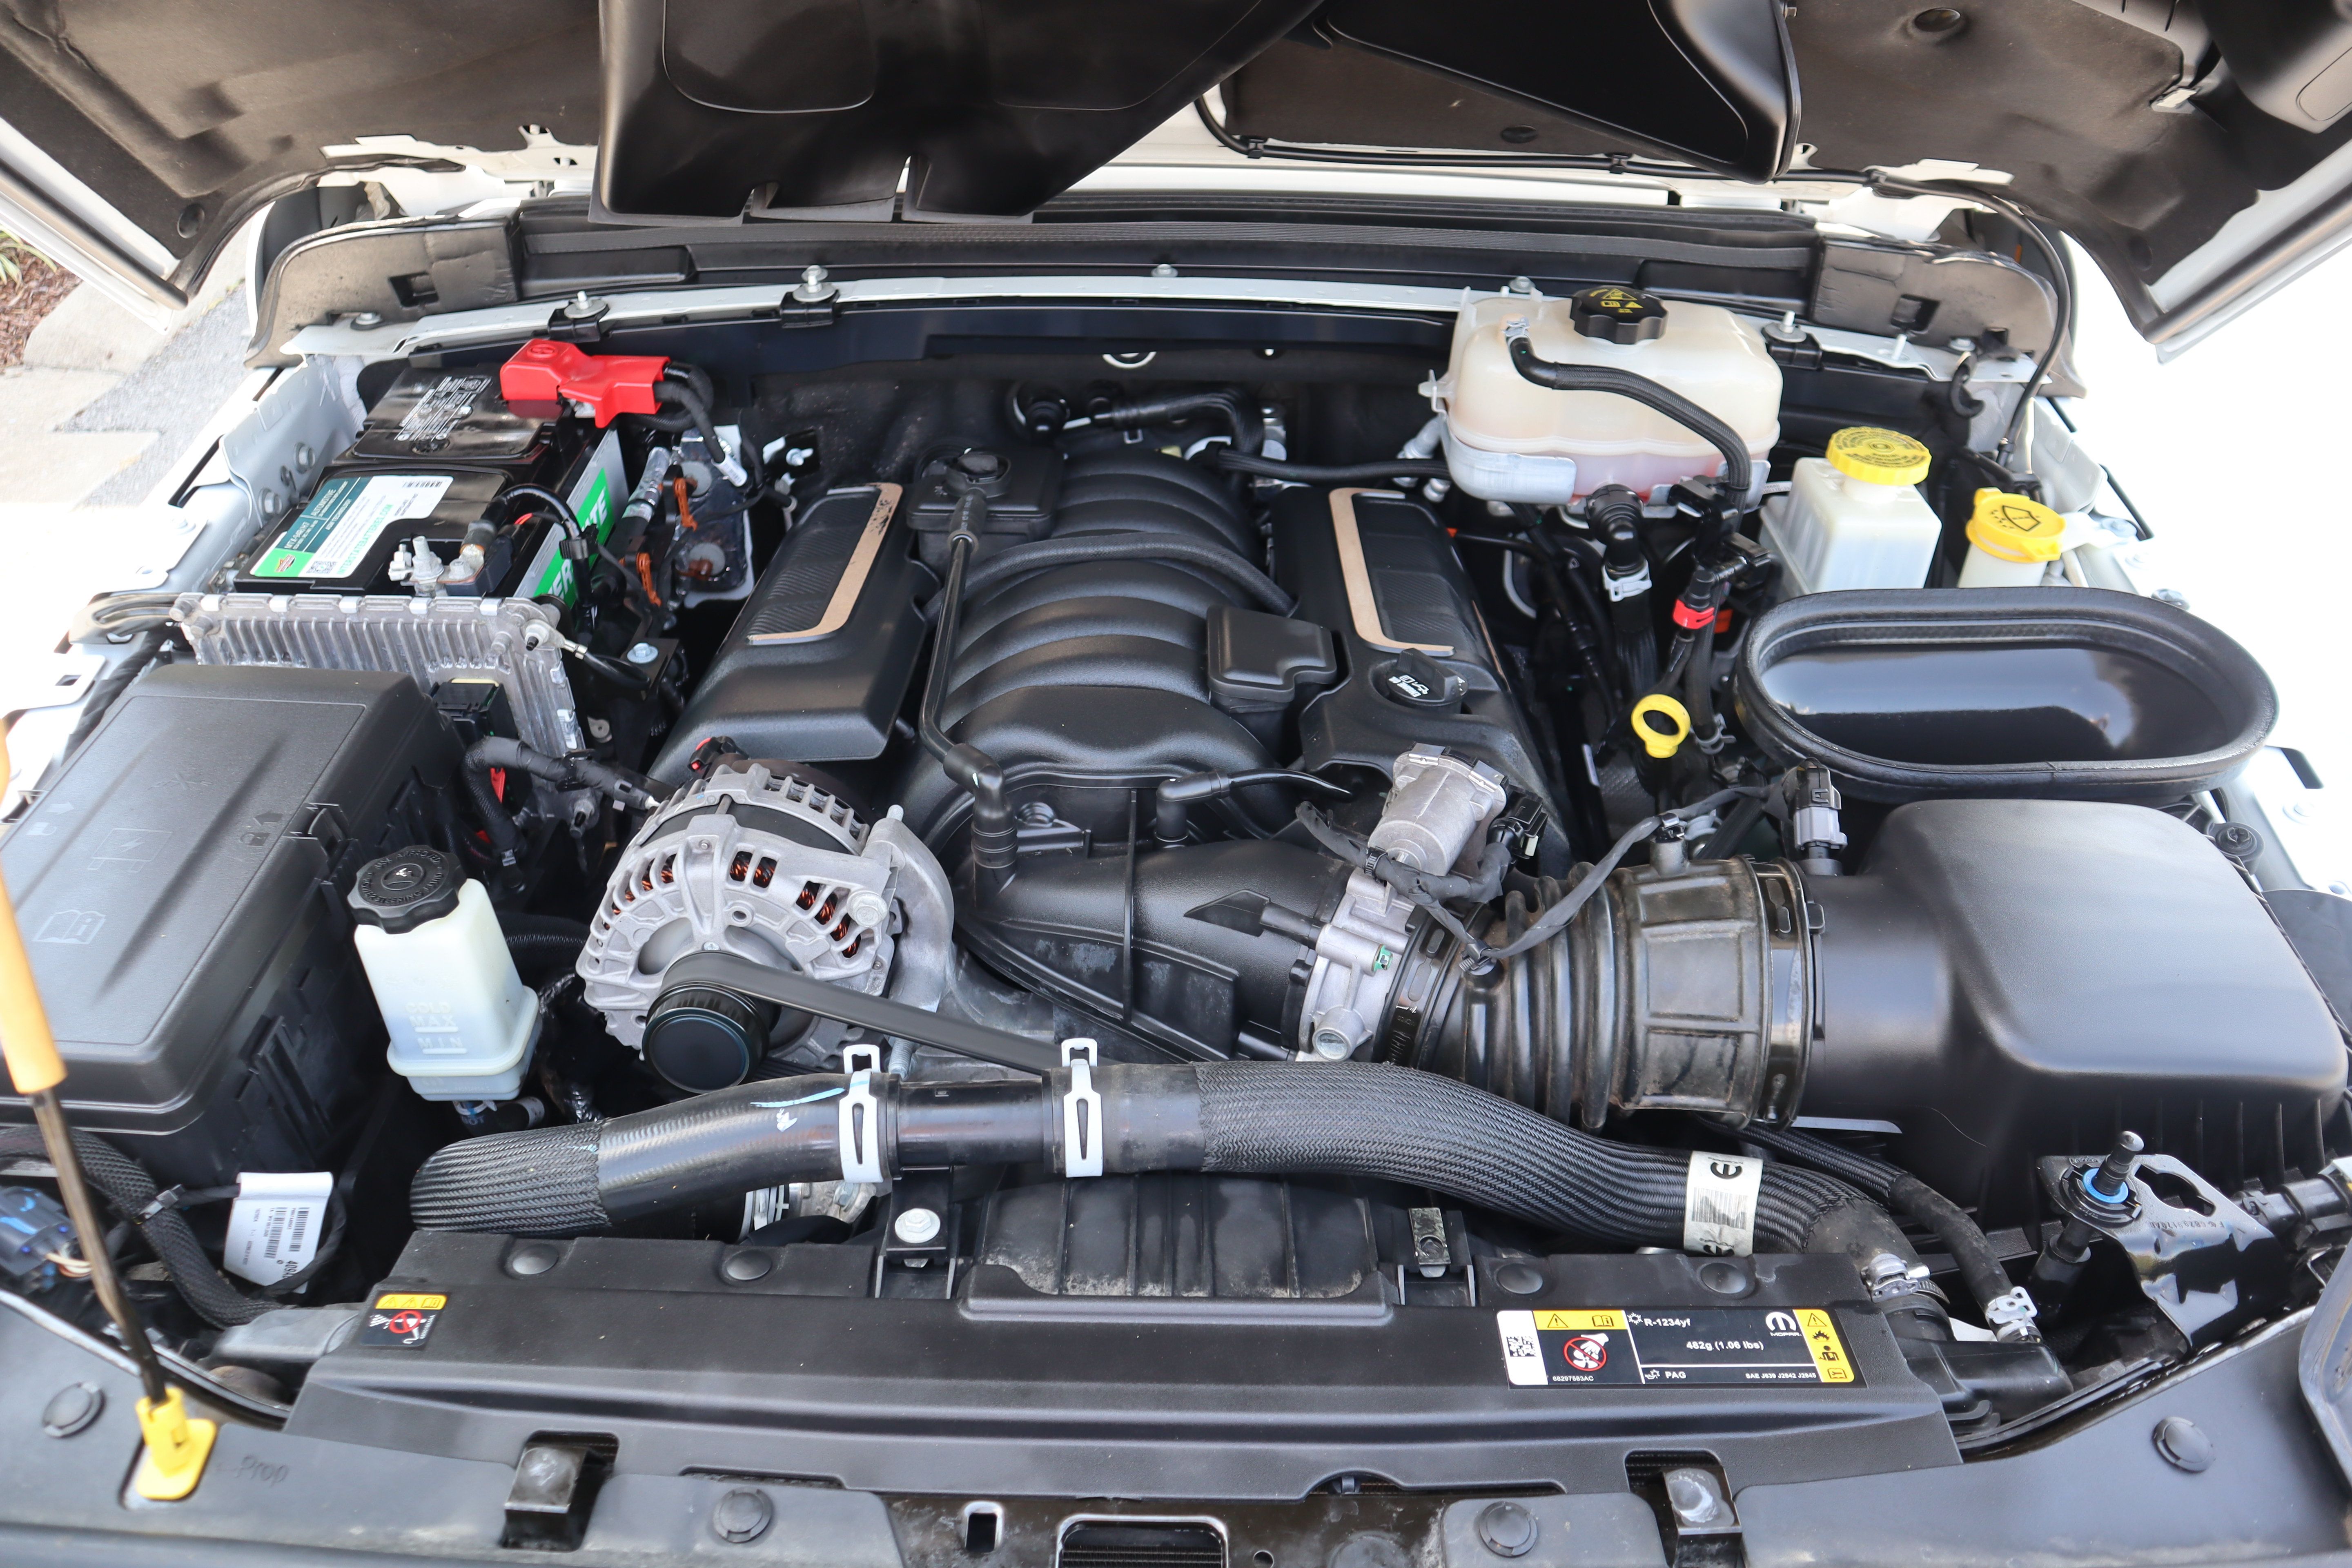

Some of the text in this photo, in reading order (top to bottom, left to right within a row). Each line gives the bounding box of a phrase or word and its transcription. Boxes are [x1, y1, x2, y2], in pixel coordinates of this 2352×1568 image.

[336, 503, 394, 575] INTERSTATEBATTERIES.COM
[1397, 682, 1421, 697] ENGINE
[396, 850, 441, 864] APPROVED
[376, 890, 423, 904] STEERING
[405, 1002, 452, 1014] COLD
[409, 1015, 457, 1027] MAX
[417, 1037, 463, 1049] MIN
[1644, 1318, 1690, 1327] R-1234yf
[1686, 1341, 1764, 1351] 482g (1.06 lbs)
[1666, 1371, 1686, 1379] PAG
